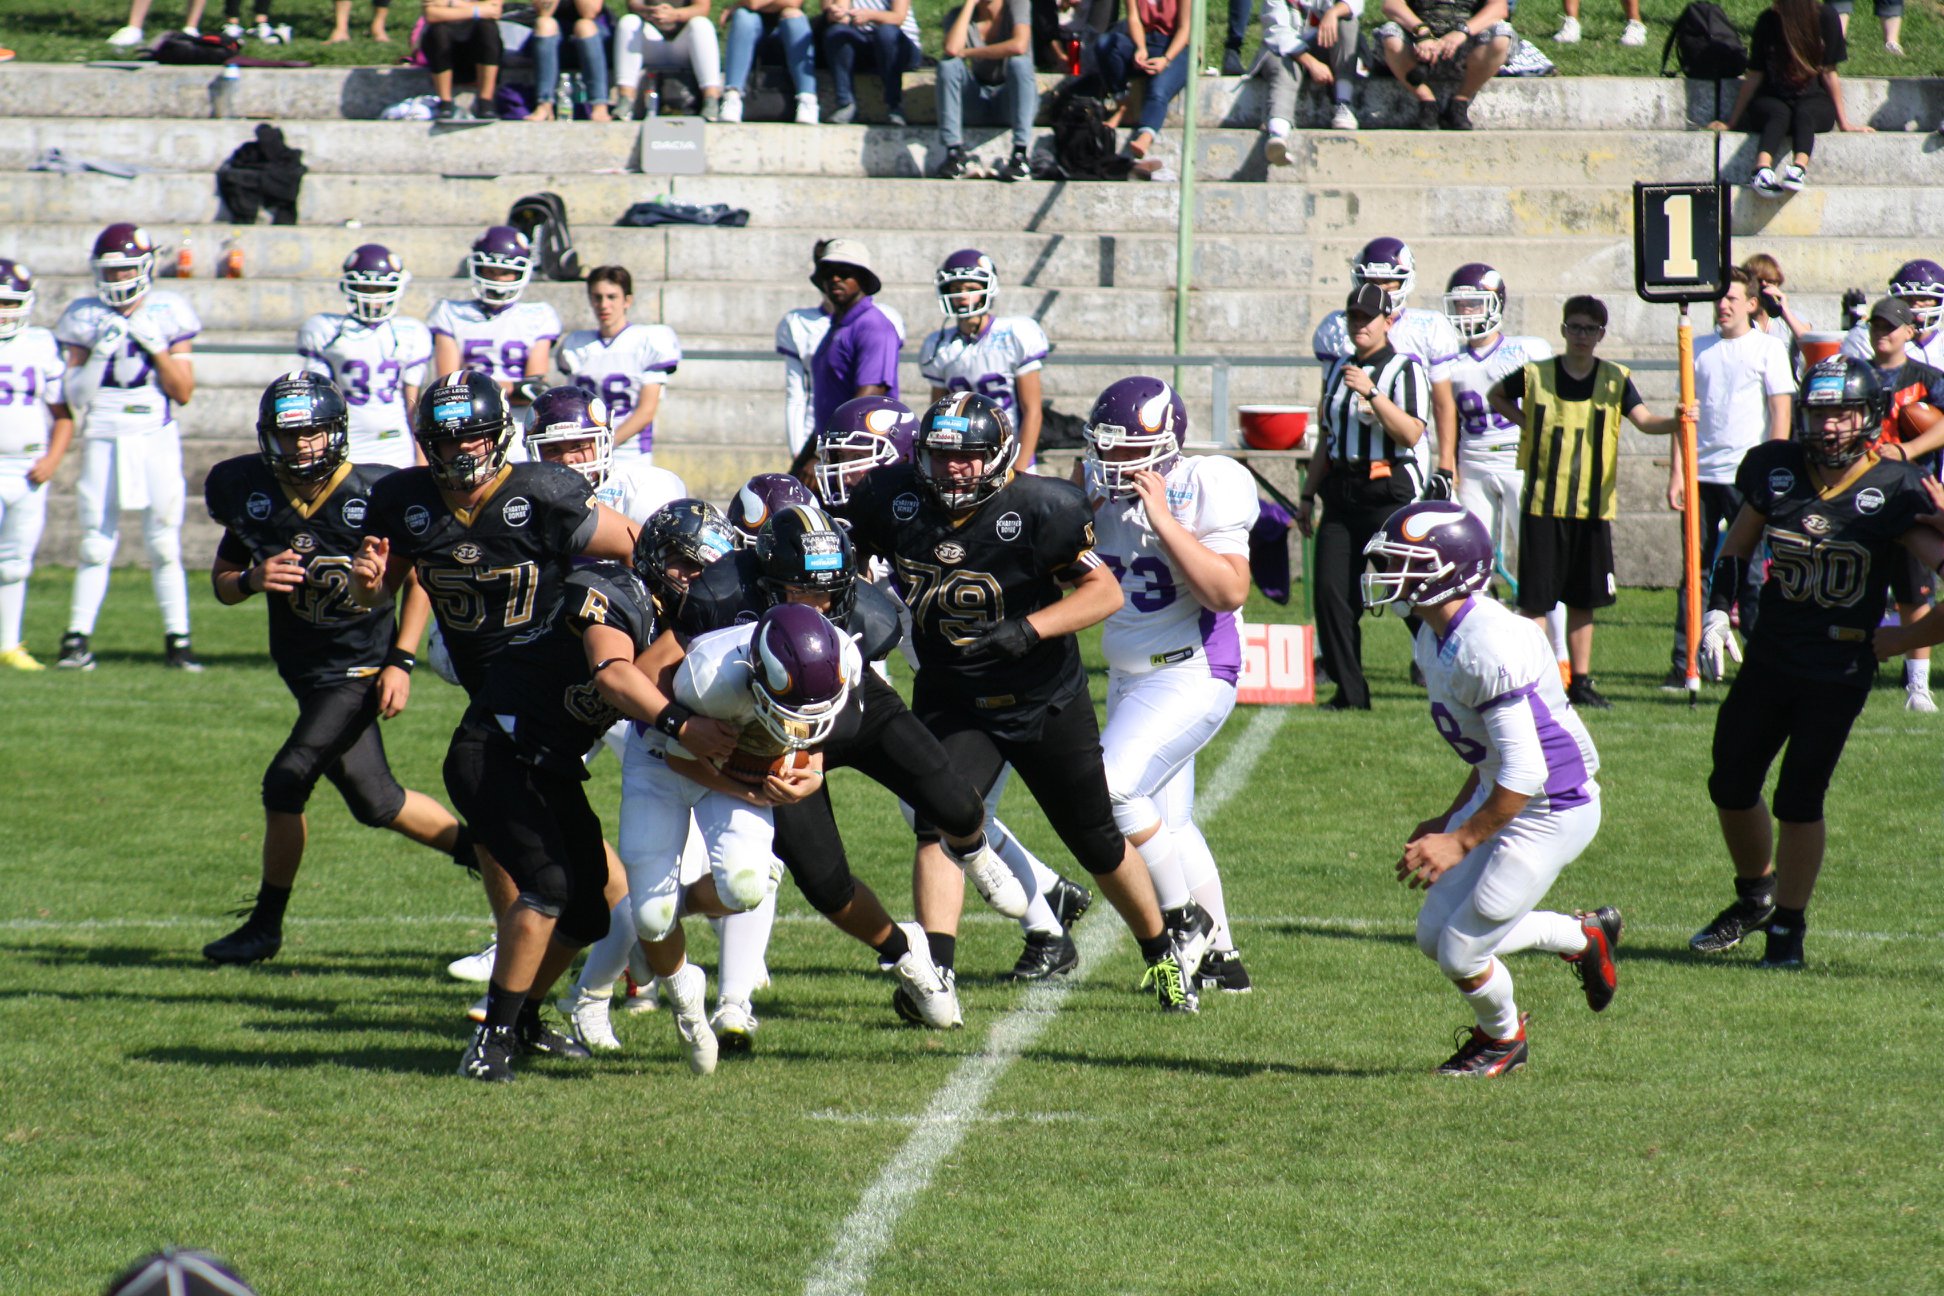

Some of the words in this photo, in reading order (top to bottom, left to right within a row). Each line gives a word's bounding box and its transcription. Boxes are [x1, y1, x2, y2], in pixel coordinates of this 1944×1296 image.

[1663, 194, 1698, 278] 1
[0, 364, 36, 406] 51
[341, 359, 400, 406] 33
[416, 560, 539, 632] 57
[894, 552, 1005, 647] 79
[1764, 524, 1871, 608] 50
[579, 586, 609, 624] R
[1430, 701, 1488, 765] 8
